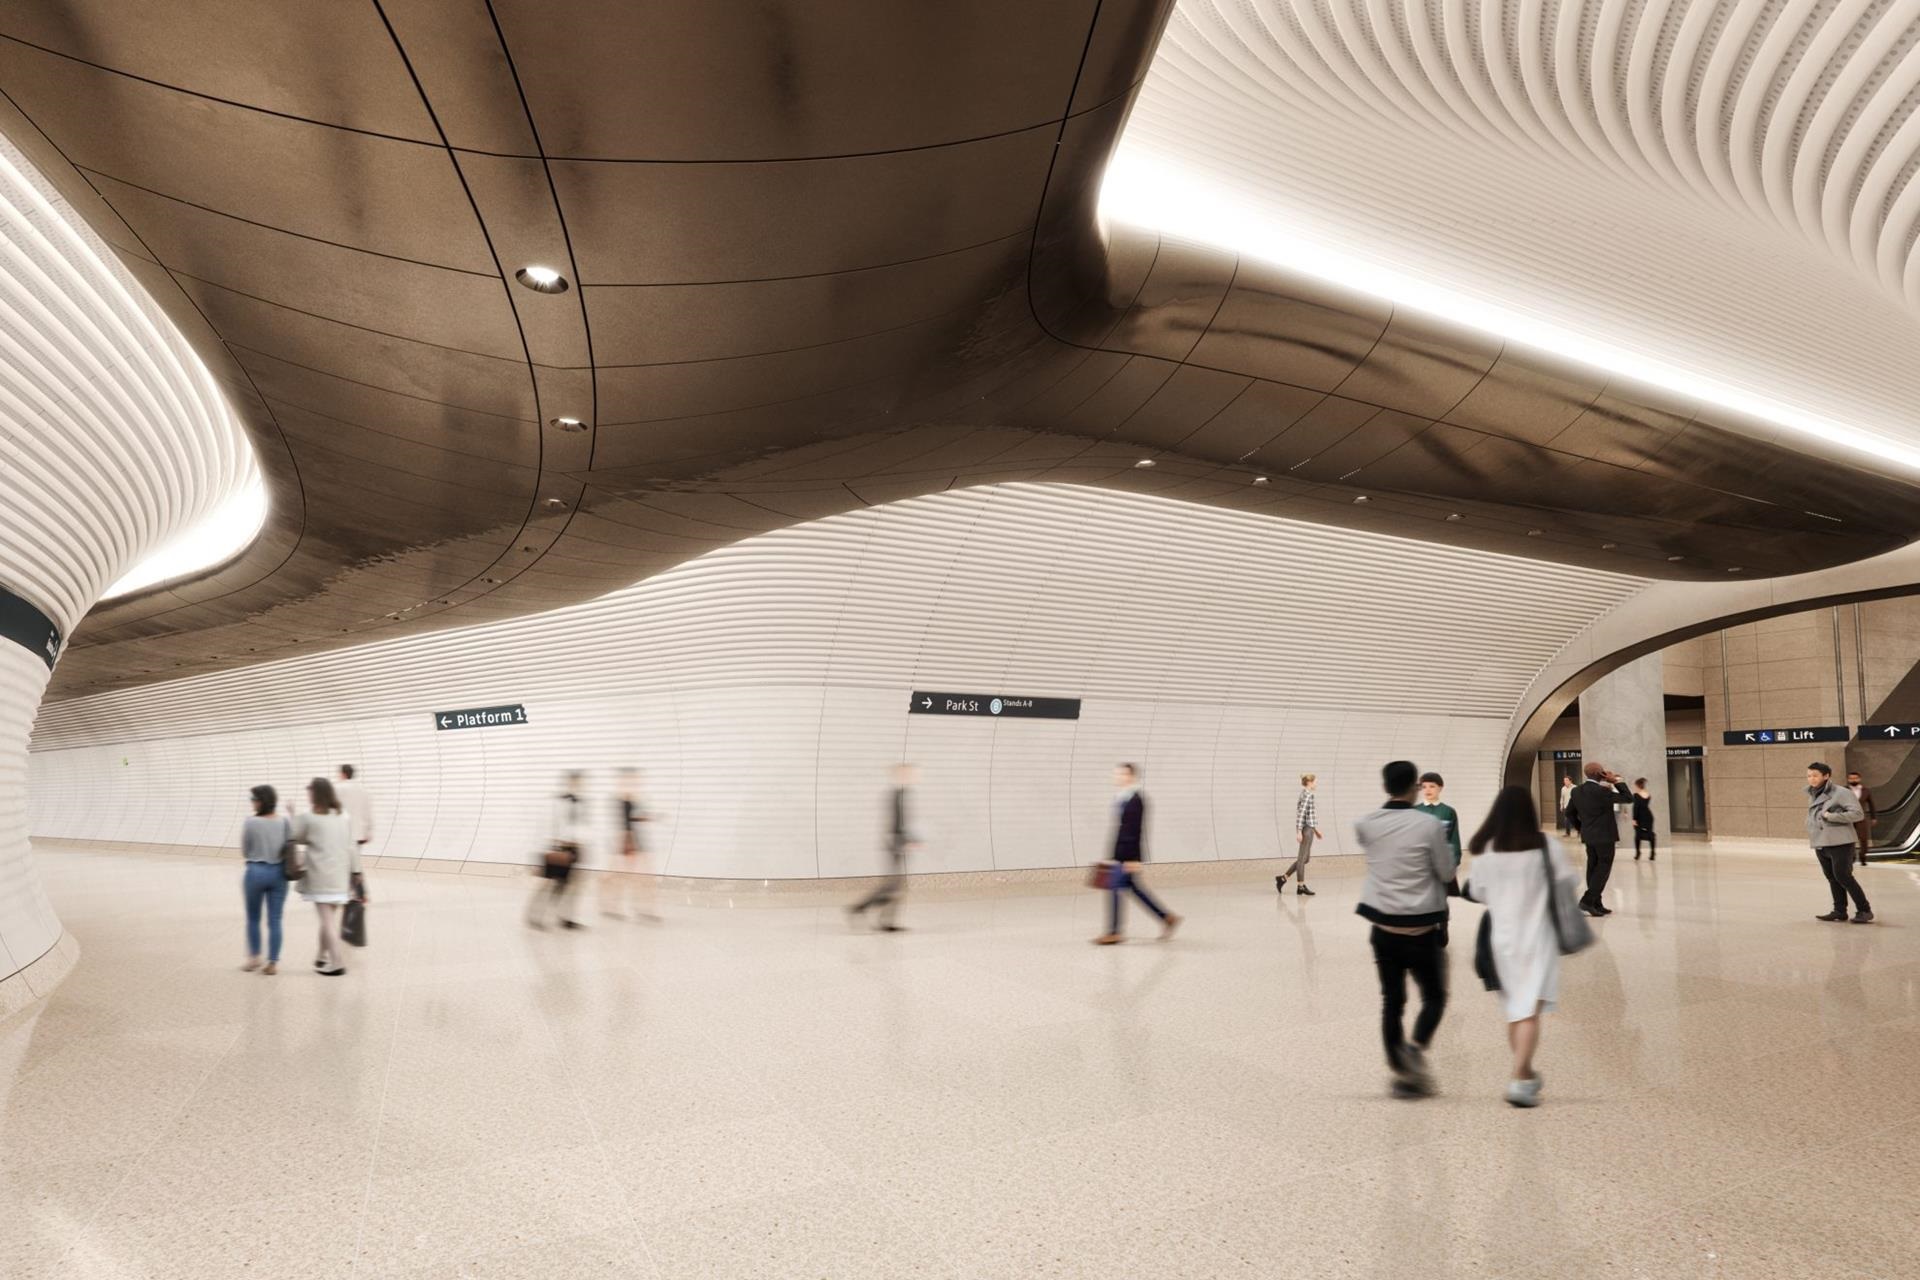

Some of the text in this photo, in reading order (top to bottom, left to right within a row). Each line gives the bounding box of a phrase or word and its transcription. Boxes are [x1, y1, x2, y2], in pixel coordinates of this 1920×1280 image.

[946, 700, 979, 711] Park St
[1003, 699, 1022, 707] Stands
[457, 708, 524, 726] Platform 1
[1793, 731, 1814, 740] Lift
[1911, 727, 1920, 736] P
